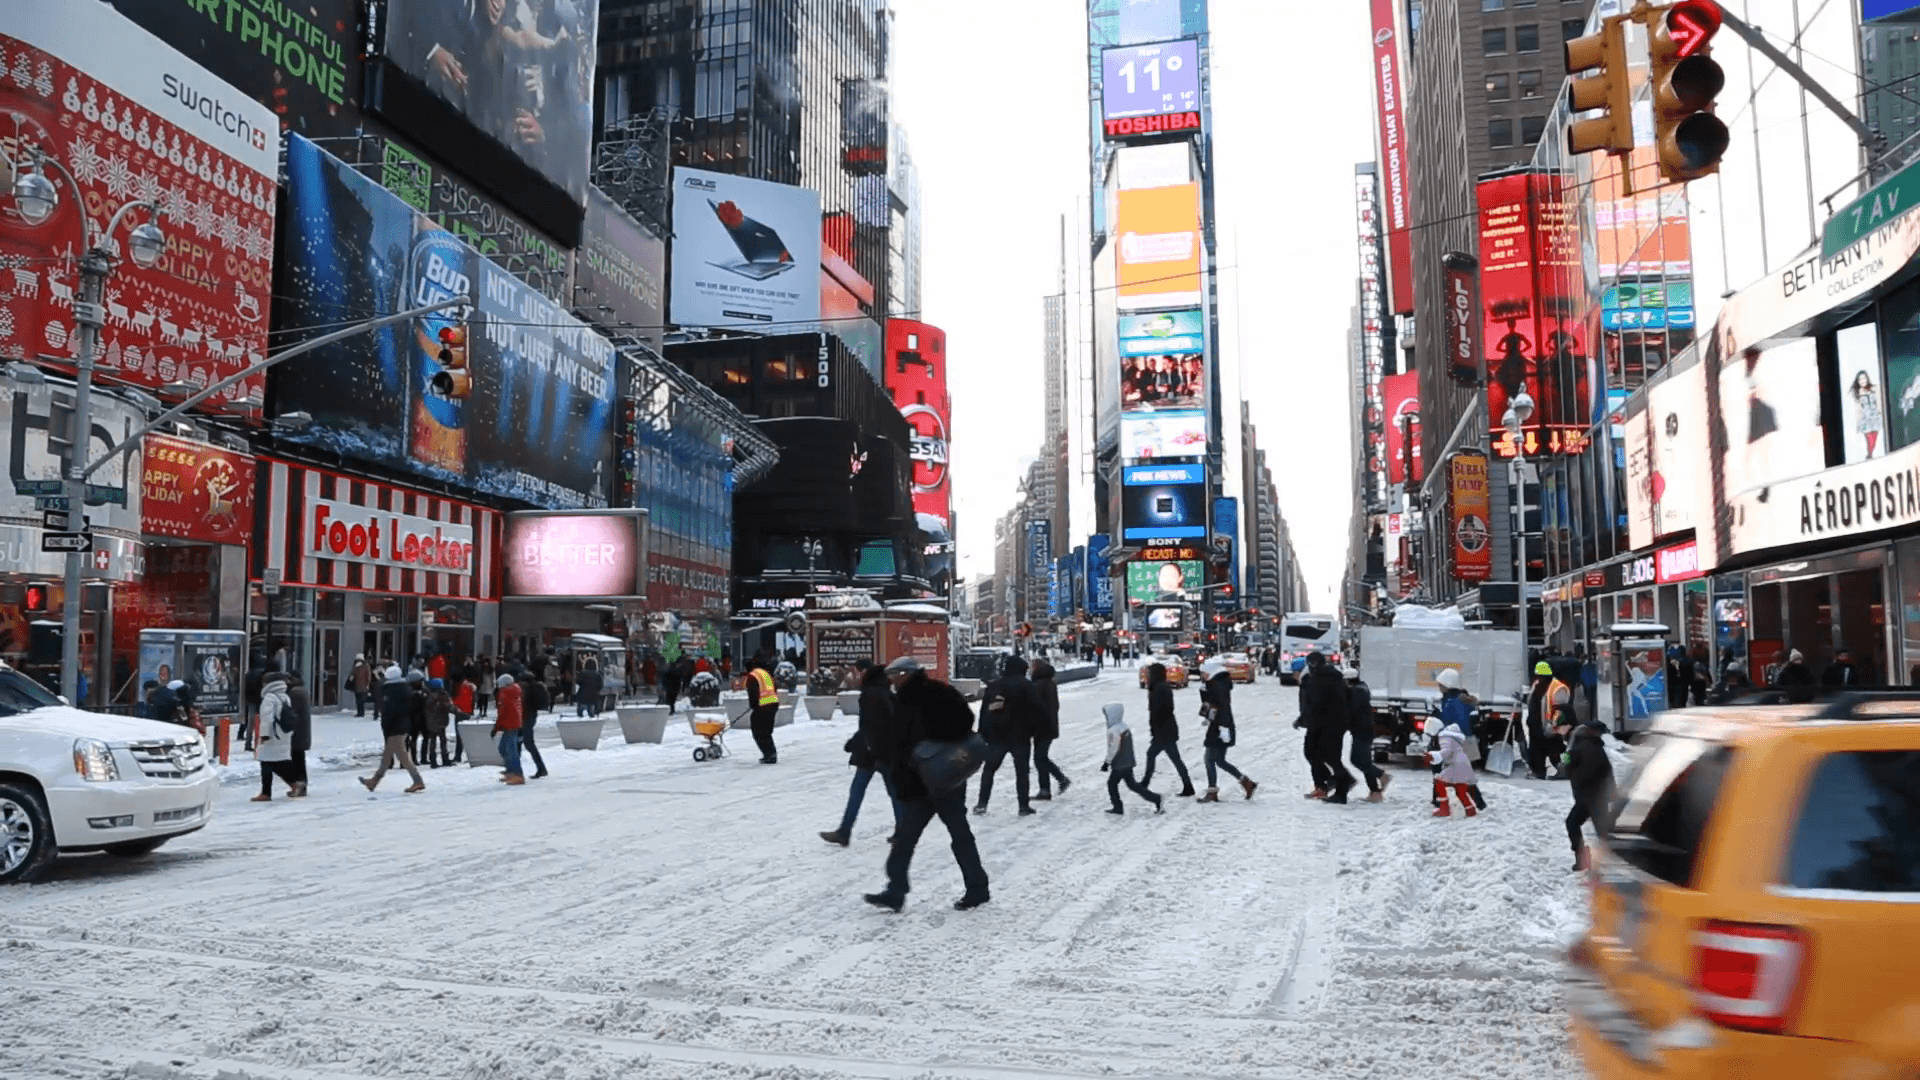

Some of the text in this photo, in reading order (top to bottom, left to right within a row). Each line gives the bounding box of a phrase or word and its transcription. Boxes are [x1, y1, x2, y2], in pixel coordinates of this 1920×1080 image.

[248, 0, 346, 69] AUTIFUL
[162, 73, 251, 144] swatch
[1105, 112, 1199, 136] TOSHIBA
[1380, 54, 1405, 229] INNOVATION THAT EXCITES
[684, 177, 716, 188] ASUS
[1852, 206, 1863, 234] 7
[1869, 187, 1900, 225] AV
[165, 234, 214, 270] APPY
[155, 256, 221, 294] OLIDAY
[426, 253, 470, 295] BUD
[487, 270, 518, 311] NOT
[520, 294, 554, 333] JUST
[555, 318, 579, 348] ANY
[486, 311, 517, 352] NOT
[518, 332, 554, 370] JUST
[555, 352, 580, 385] ANY
[145, 470, 180, 487] APPY
[1454, 461, 1485, 475] BUBBA
[1456, 478, 1484, 491] GUMP
[142, 487, 184, 505] LIDAY
[315, 505, 473, 571] Foot Locker
[524, 543, 616, 566] BETTER
[1147, 538, 1183, 546] SONY
[752, 598, 767, 608] THE
